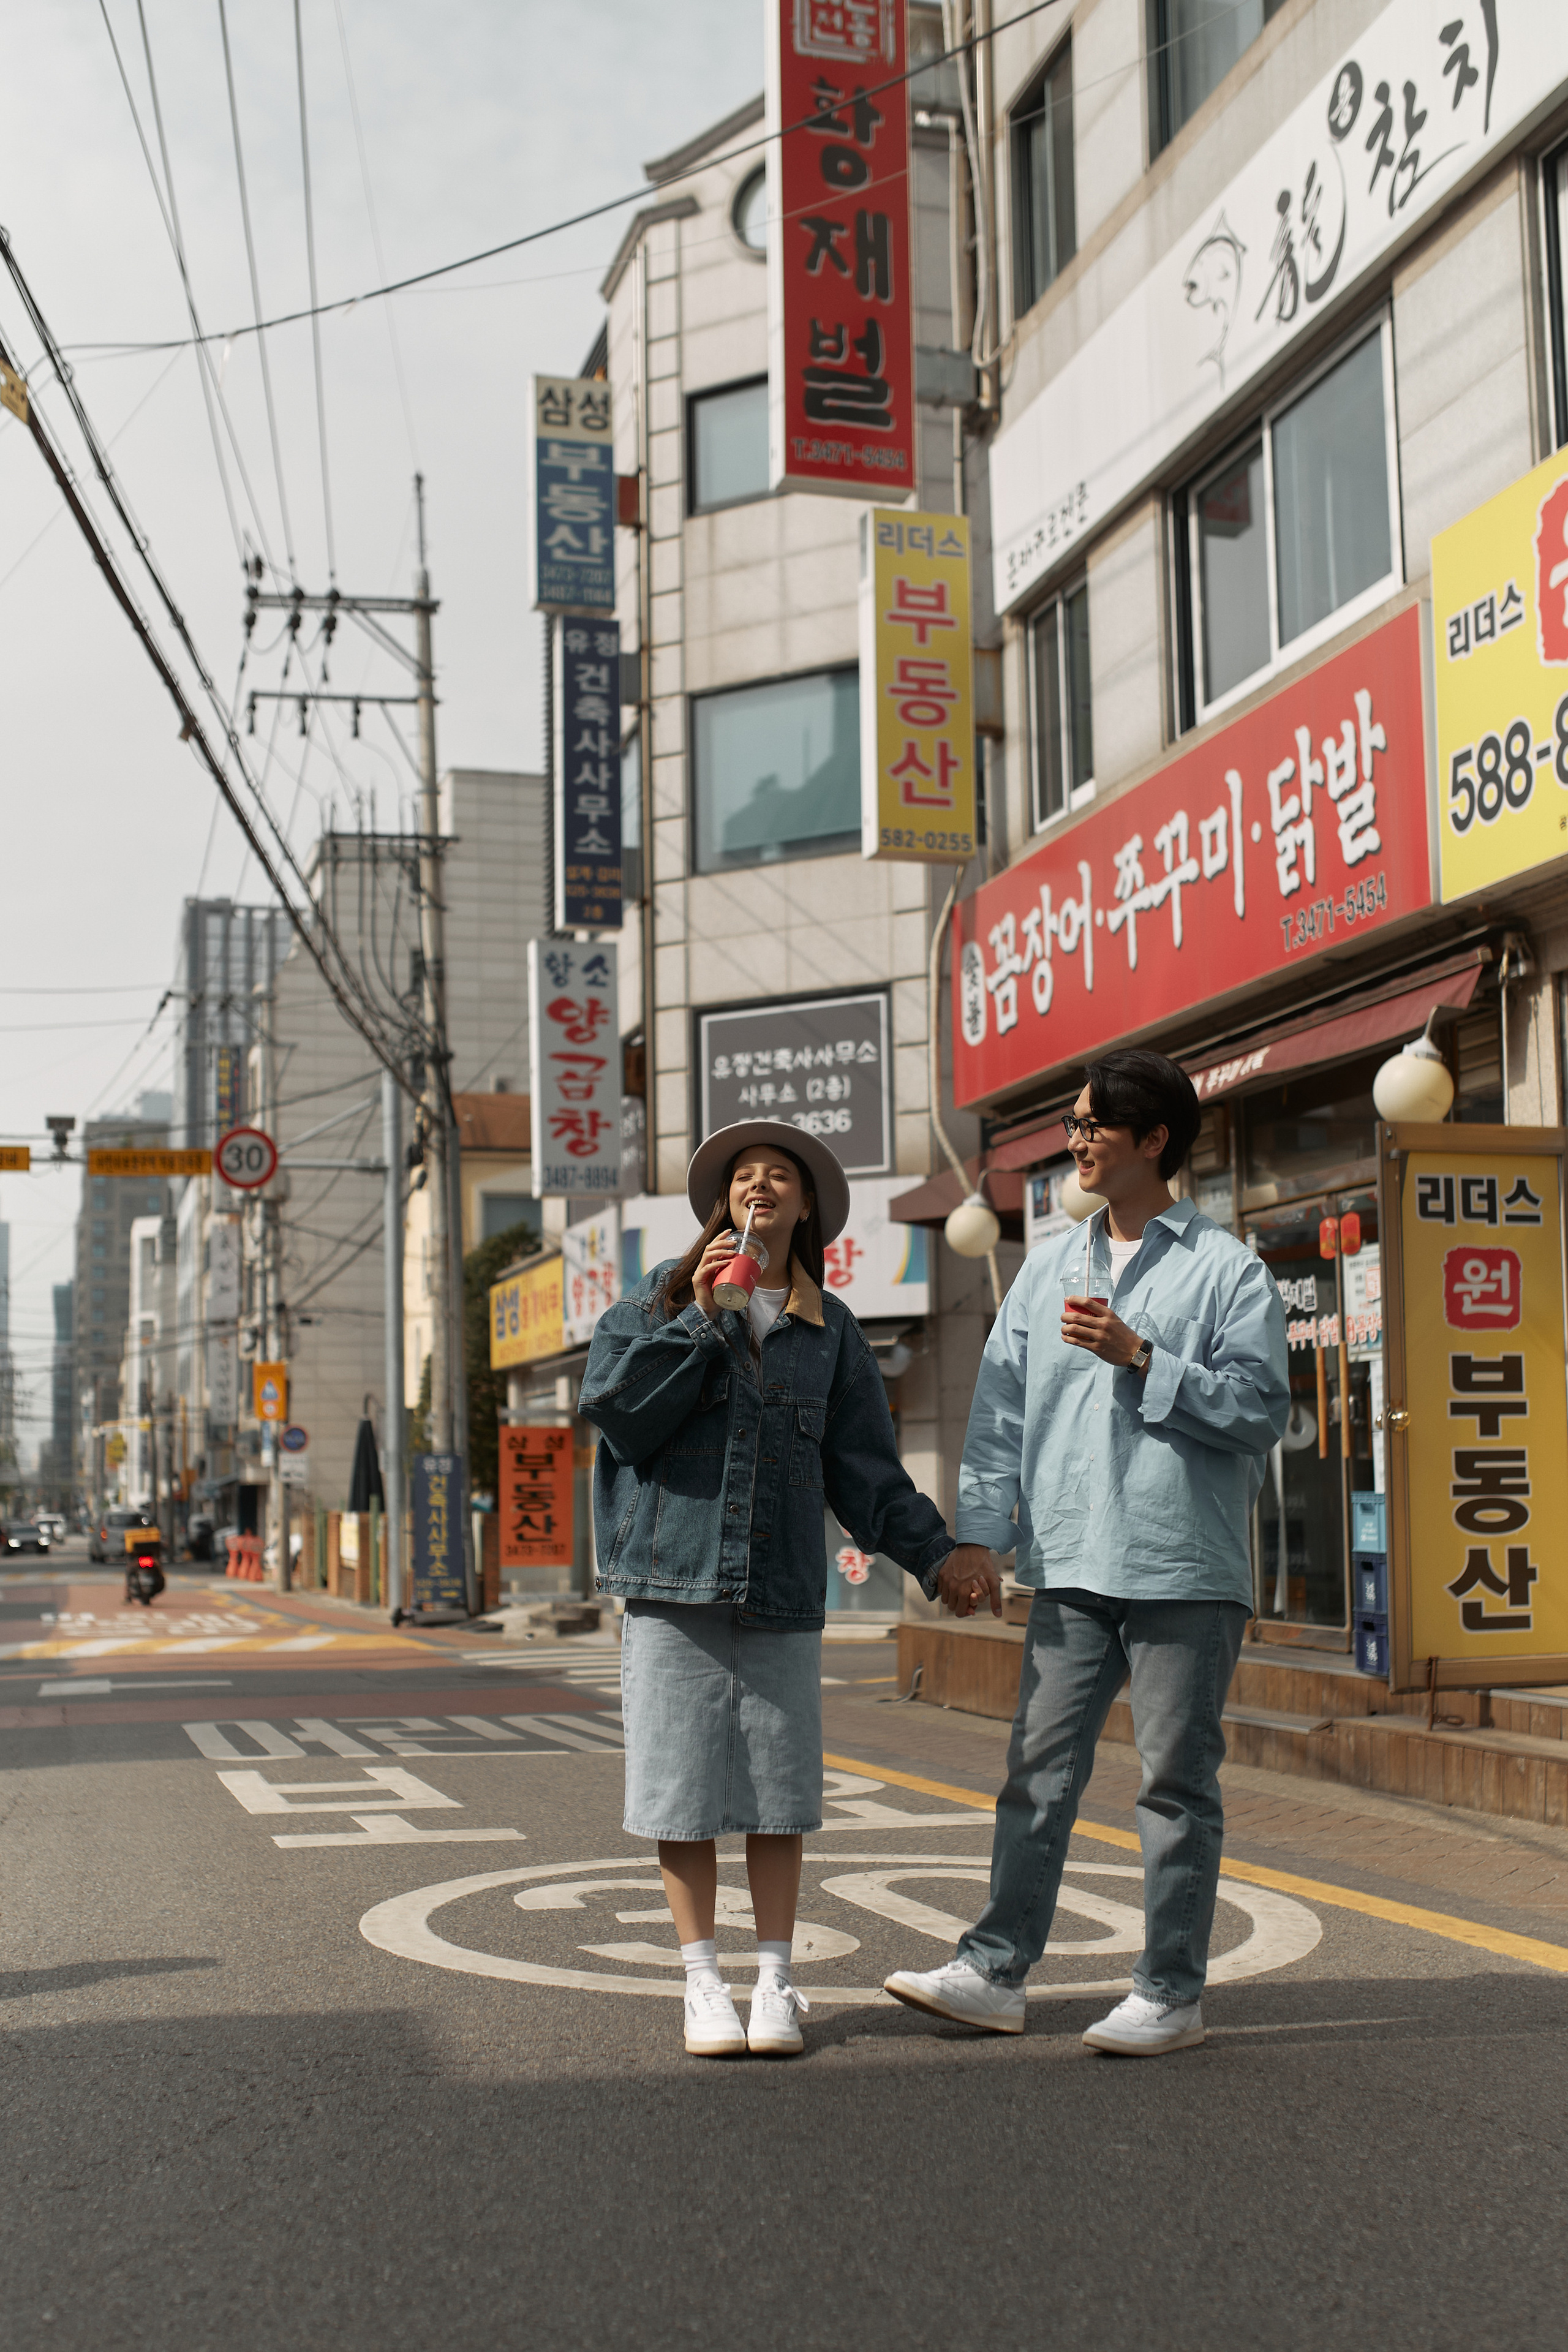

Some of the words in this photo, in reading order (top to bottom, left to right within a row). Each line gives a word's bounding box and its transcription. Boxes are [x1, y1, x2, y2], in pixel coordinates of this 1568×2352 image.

[540, 385, 609, 431] 삼성
[793, 438, 905, 470] T.3471-5454
[540, 442, 609, 564] 부동산
[878, 522, 965, 557] 리더스
[1449, 584, 1523, 657] 리더스
[886, 578, 959, 807] 부동산
[573, 663, 612, 854] 건축사사무소
[881, 828, 972, 851] 582-0255
[1281, 872, 1388, 952] T.3471-5454
[546, 997, 612, 1158] 양곱창
[711, 1039, 878, 1079] 유정건축사사무소
[738, 1081, 798, 1108] 사무소
[805, 1074, 851, 1102] (2층)
[224, 1144, 264, 1174] 30
[1418, 1176, 1542, 1225] 리더스
[1453, 1259, 1513, 1315] 원
[512, 1453, 556, 1542] 부동산
[1446, 1354, 1538, 1631] 부동산
[429, 1476, 449, 1577] 건축사사무소
